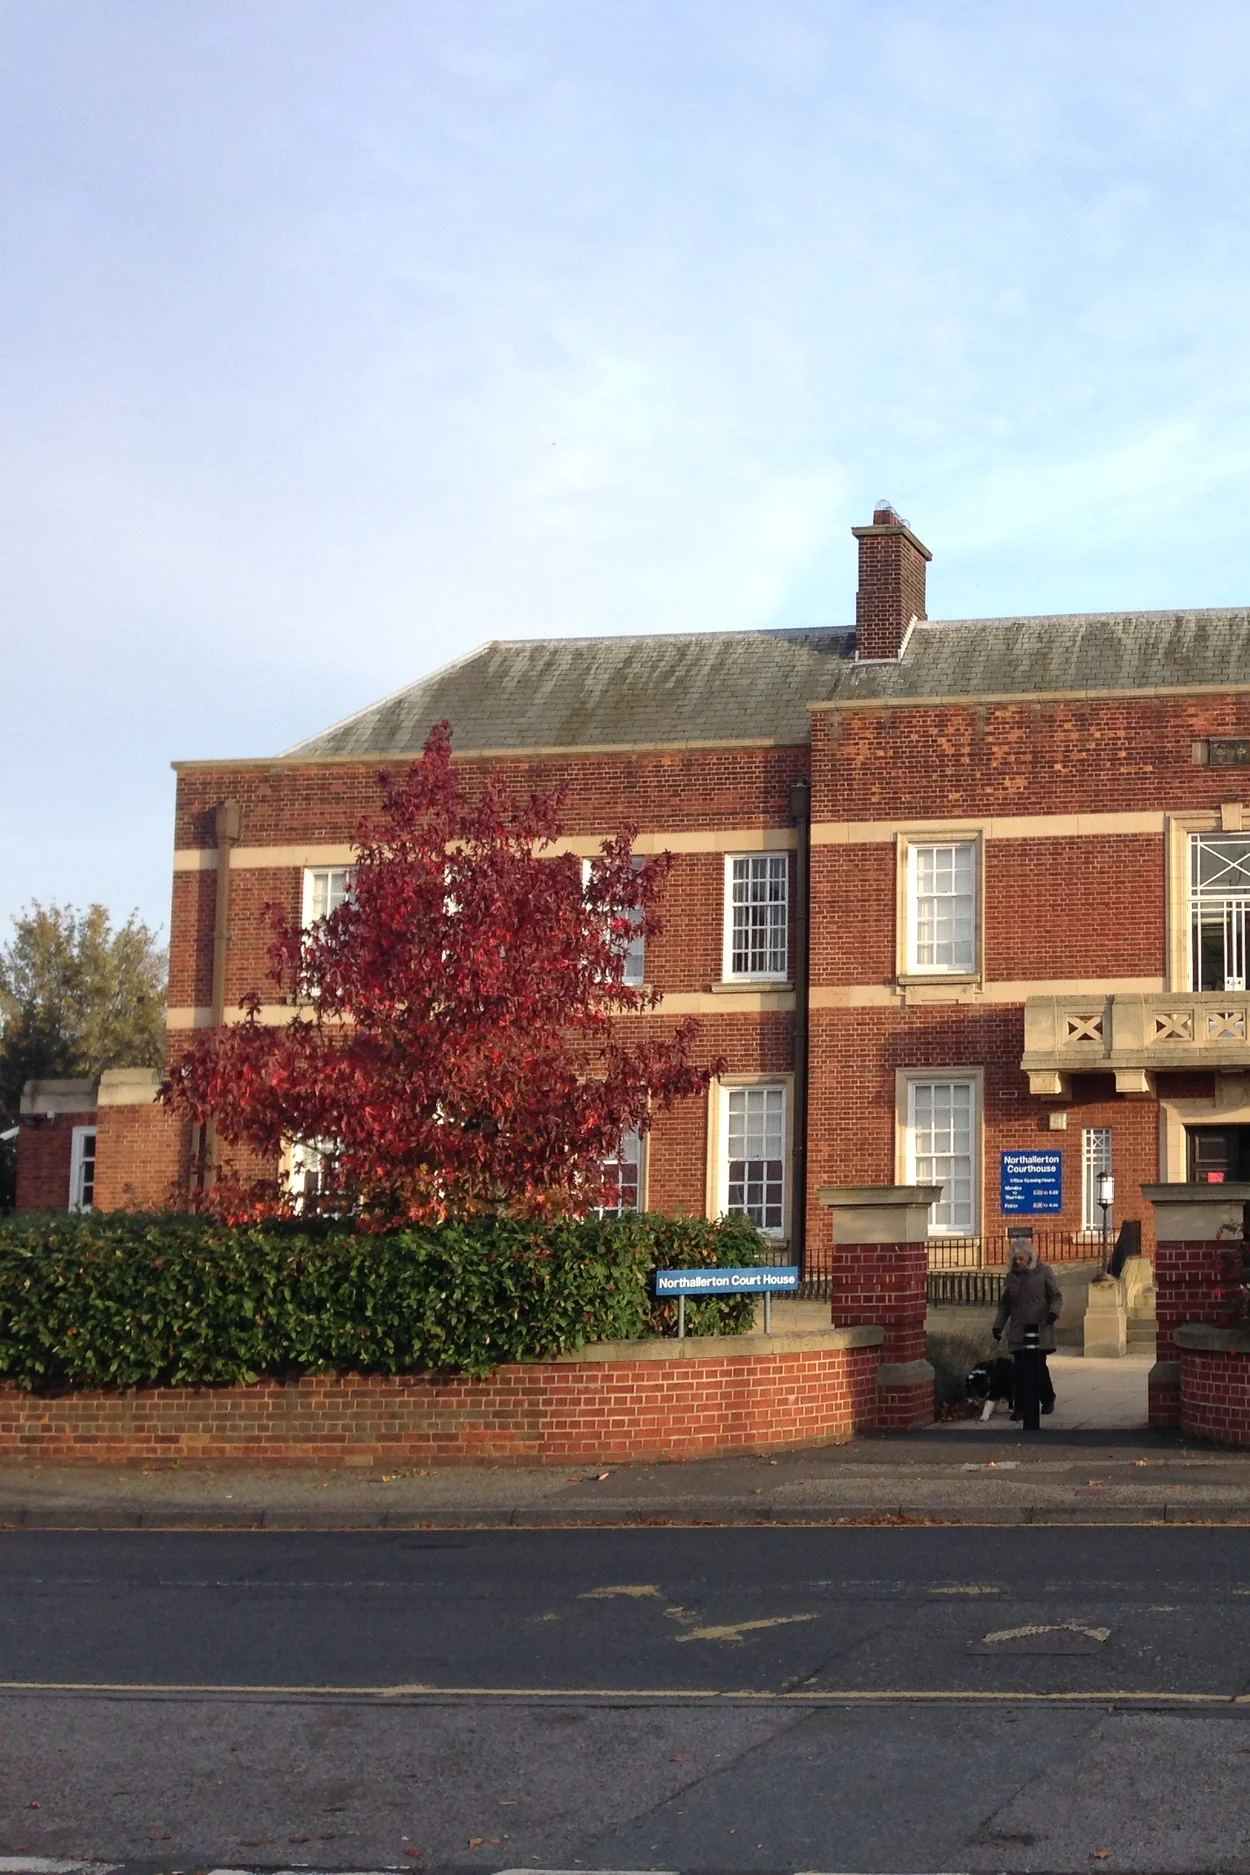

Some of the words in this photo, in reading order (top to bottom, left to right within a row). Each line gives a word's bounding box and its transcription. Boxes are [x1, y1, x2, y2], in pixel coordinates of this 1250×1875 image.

[1003, 1155, 1060, 1164] Northallerton
[1007, 1164, 1057, 1173] Courthouse
[658, 1276, 730, 1289] Northallerton
[731, 1274, 761, 1286] Court
[763, 1274, 795, 1285] House
